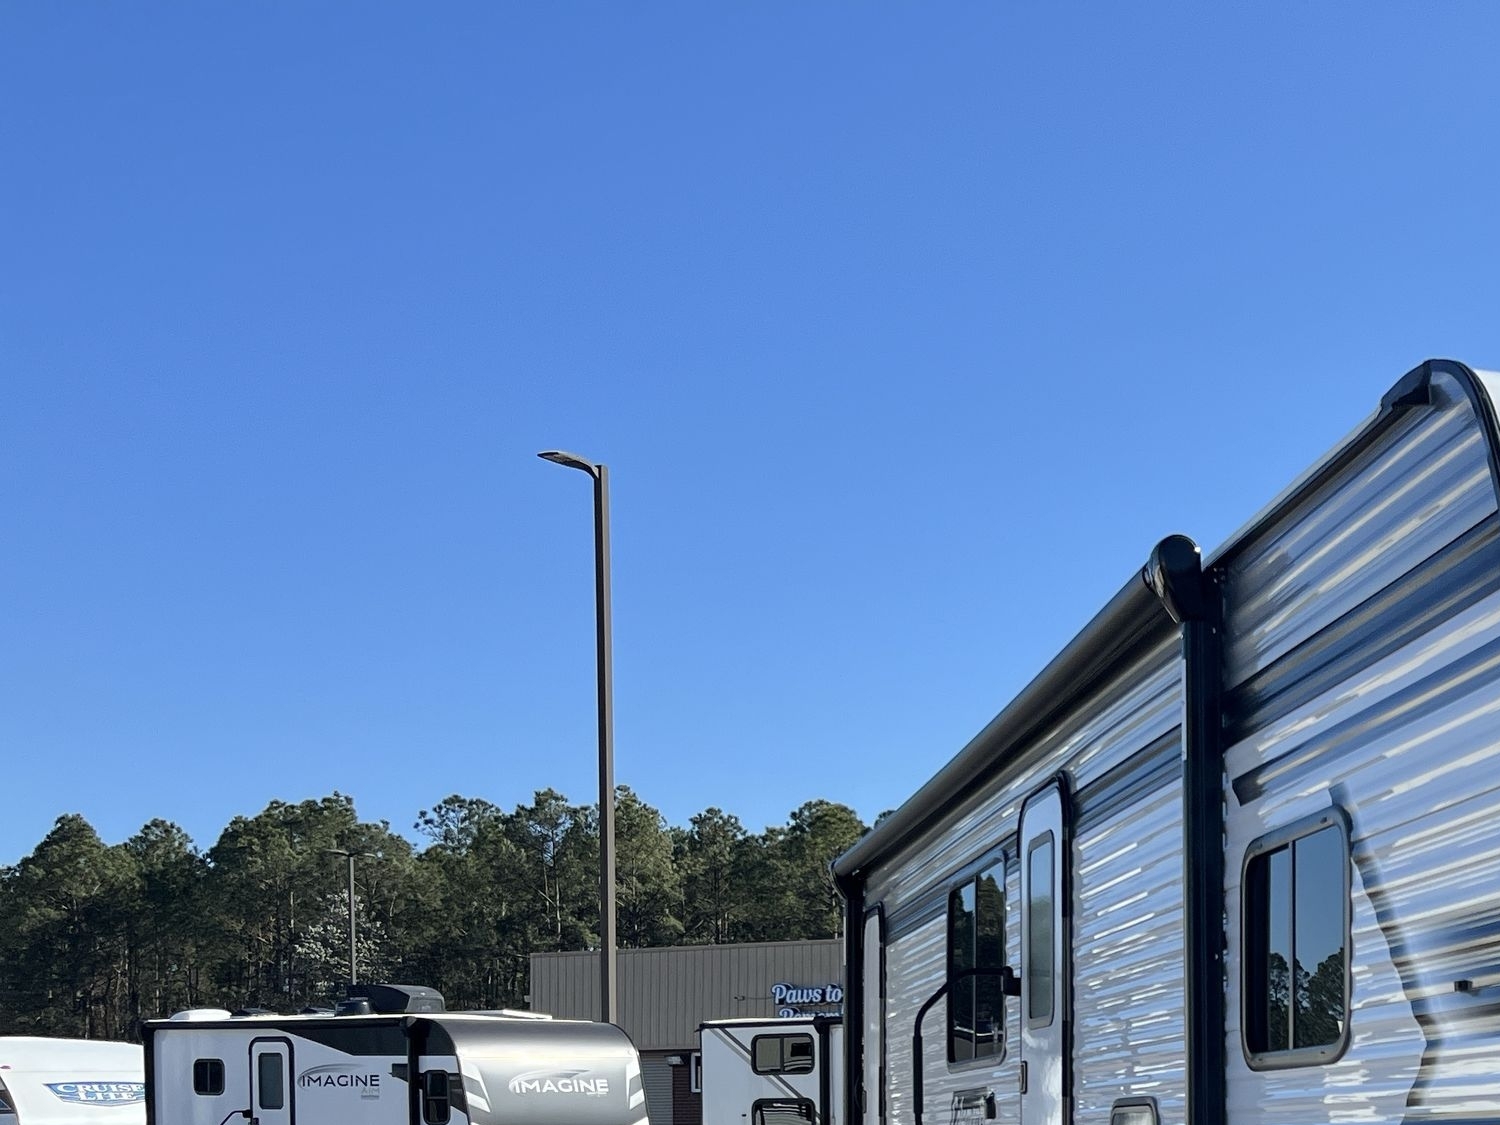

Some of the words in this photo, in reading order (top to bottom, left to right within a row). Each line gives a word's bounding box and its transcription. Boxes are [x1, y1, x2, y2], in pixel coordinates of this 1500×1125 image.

[771, 984, 822, 1004] Paws
[825, 984, 842, 1002] to
[302, 1074, 380, 1087] IMAGINE
[514, 1079, 609, 1093] IMAGINE
[57, 1084, 145, 1093] CRUISE
[78, 1092, 137, 1100] LITE
